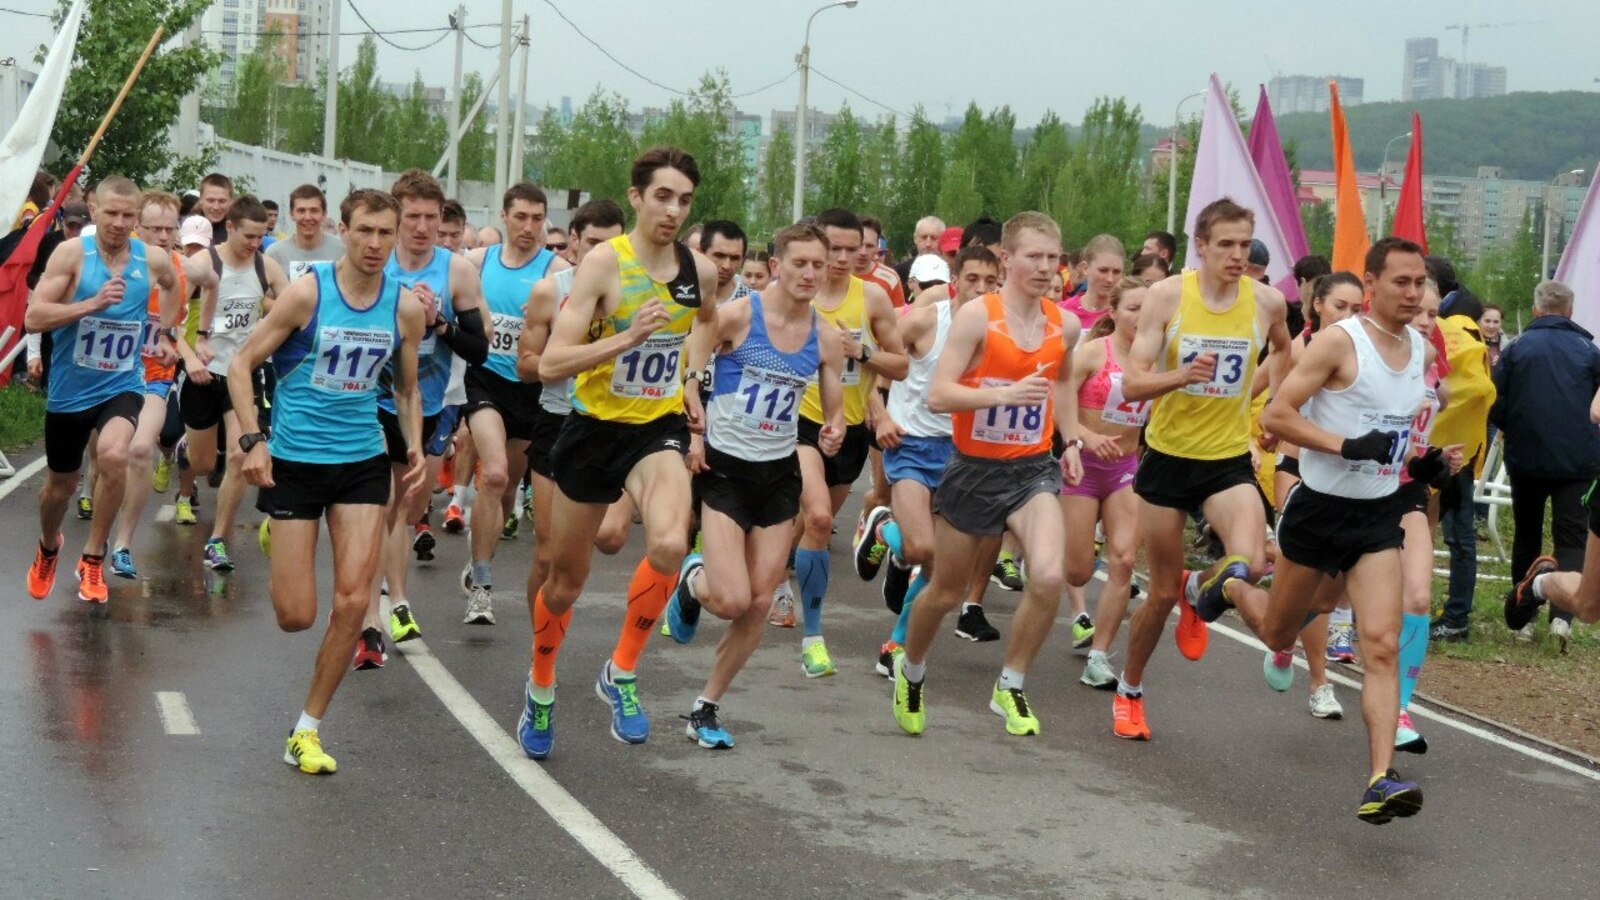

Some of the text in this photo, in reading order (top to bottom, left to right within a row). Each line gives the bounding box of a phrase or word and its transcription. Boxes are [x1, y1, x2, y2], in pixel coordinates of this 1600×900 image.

[81, 331, 135, 360] 110
[491, 331, 520, 351] 39
[322, 344, 388, 379] 117
[621, 350, 680, 384] 109
[341, 382, 360, 391] УФА
[641, 386, 661, 397] УФА
[1202, 386, 1221, 395] УФА
[741, 383, 796, 422] 112
[757, 421, 774, 432] УФА
[1002, 433, 1021, 442] УФА
